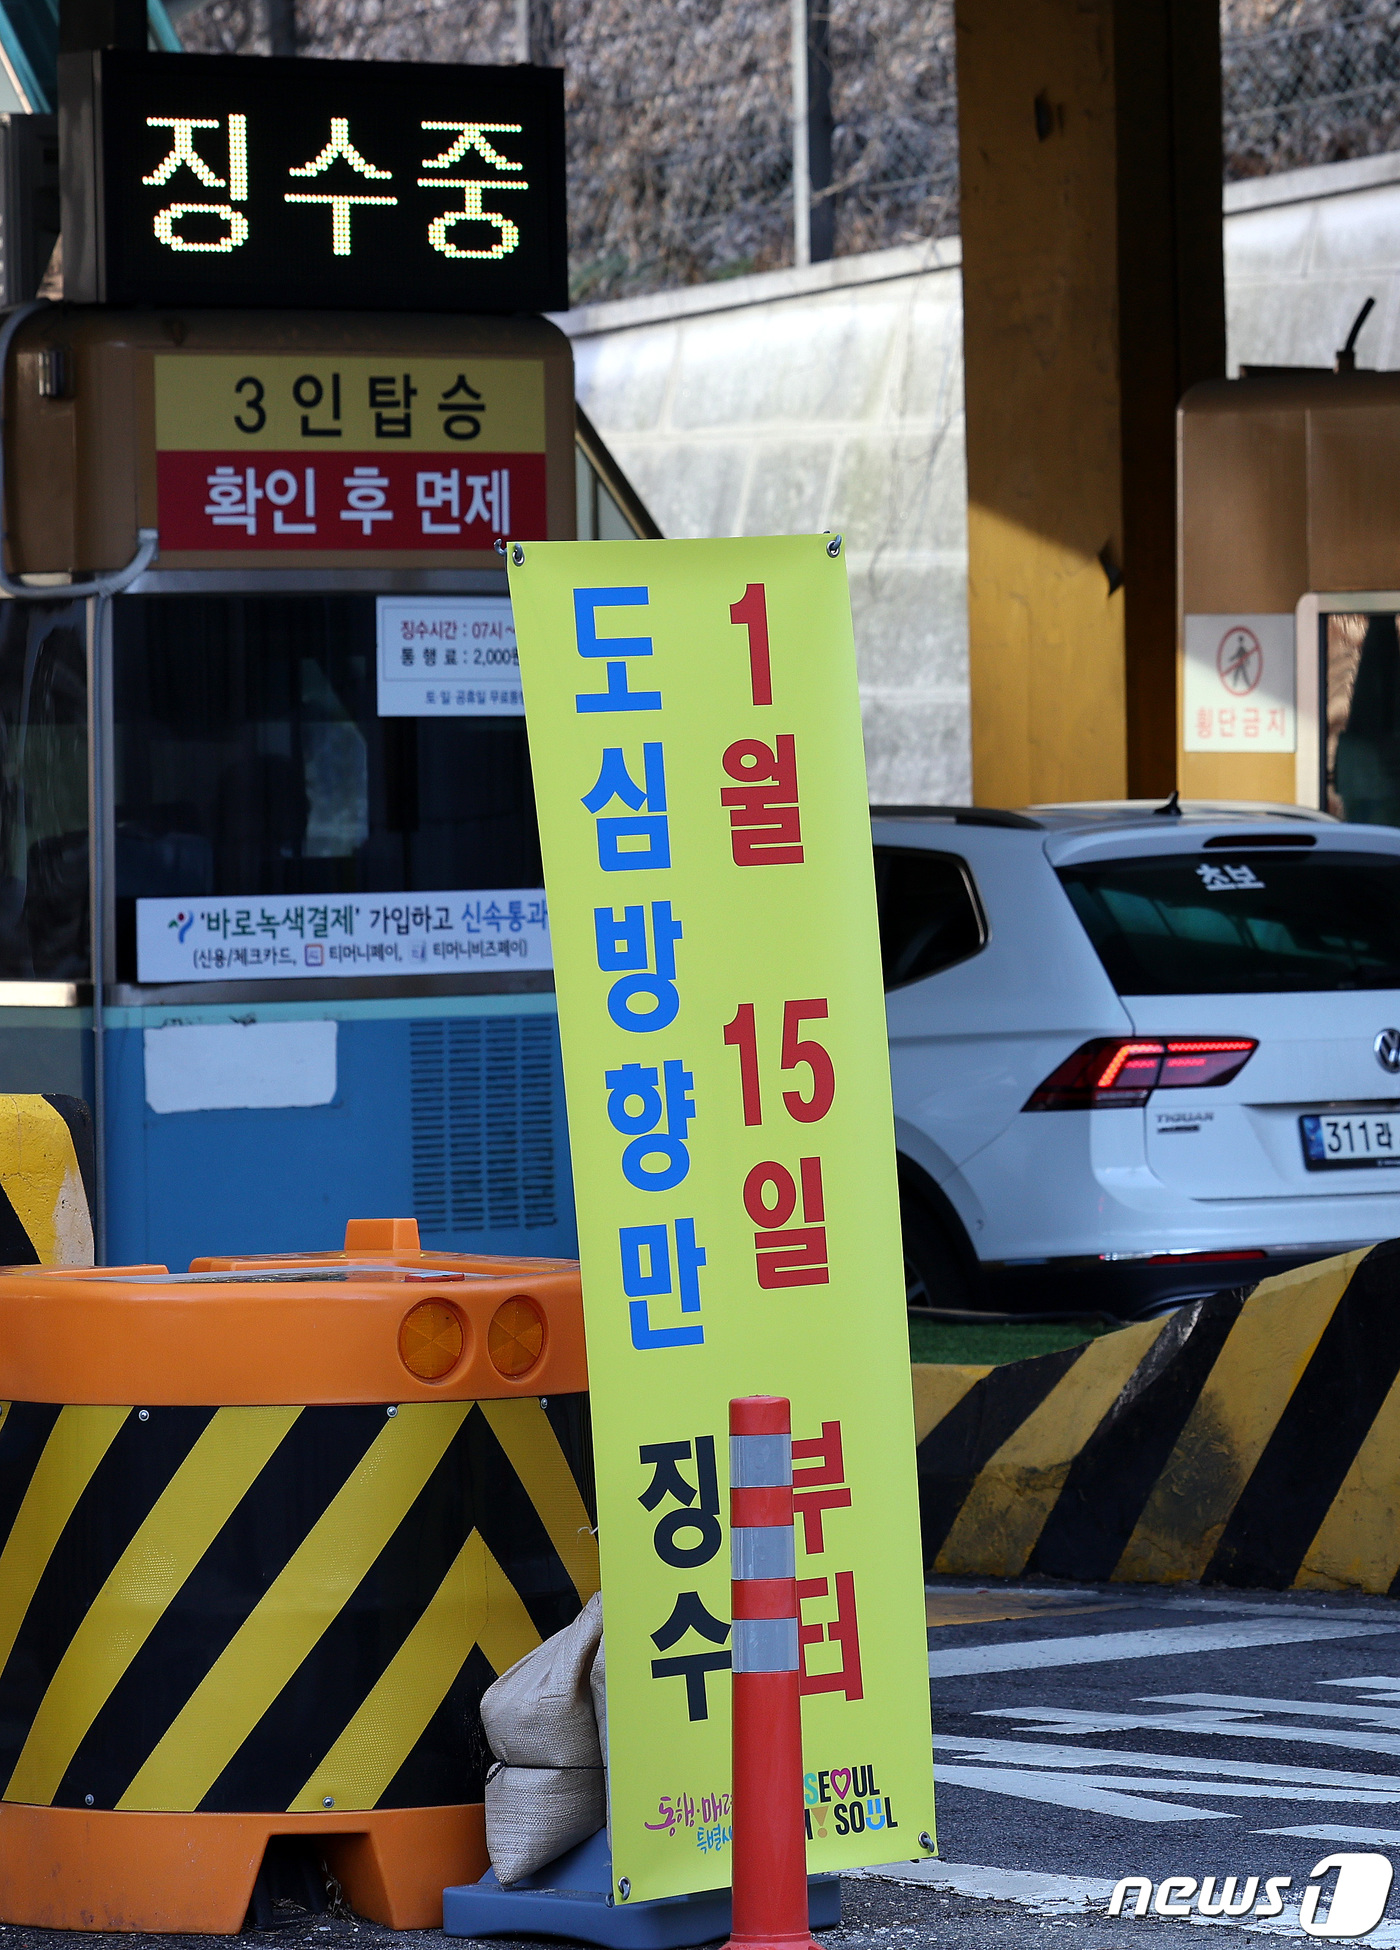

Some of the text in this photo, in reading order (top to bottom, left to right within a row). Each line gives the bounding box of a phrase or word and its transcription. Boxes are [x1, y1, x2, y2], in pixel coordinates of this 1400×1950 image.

[204, 466, 511, 535] 확인 후 면제
[401, 620, 458, 640] 징수시간
[1195, 705, 1287, 739] 횡단금지
[1196, 863, 1267, 891] 초보
[370, 904, 454, 935] 가입하고
[572, 586, 733, 1723] 도심방향만 징수
